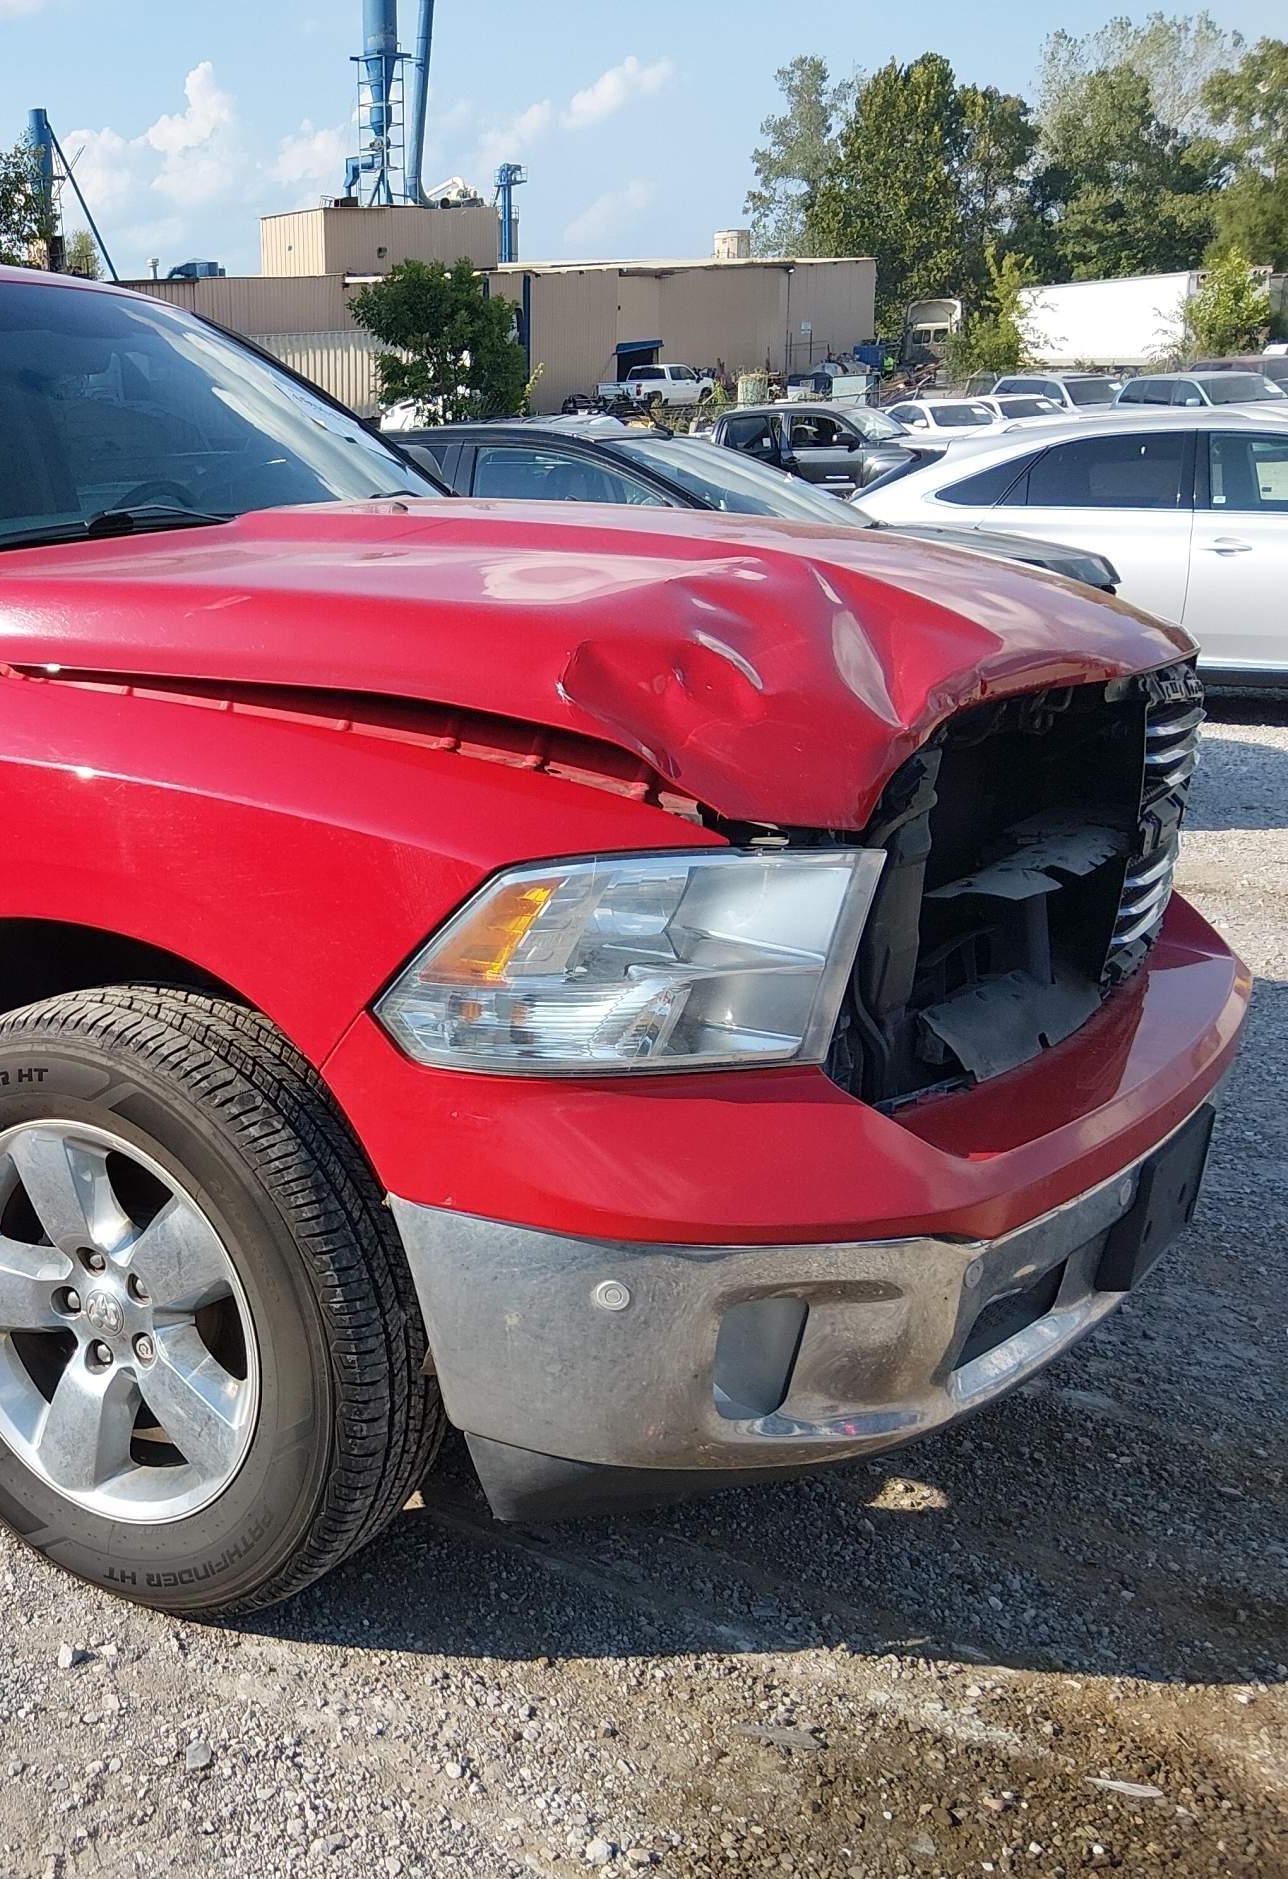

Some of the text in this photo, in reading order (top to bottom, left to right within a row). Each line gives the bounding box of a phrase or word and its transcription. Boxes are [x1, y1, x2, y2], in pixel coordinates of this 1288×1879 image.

[17, 1067, 49, 1083] HT
[145, 1504, 275, 1588] PATHFINDER
[103, 1565, 137, 1586] HT
